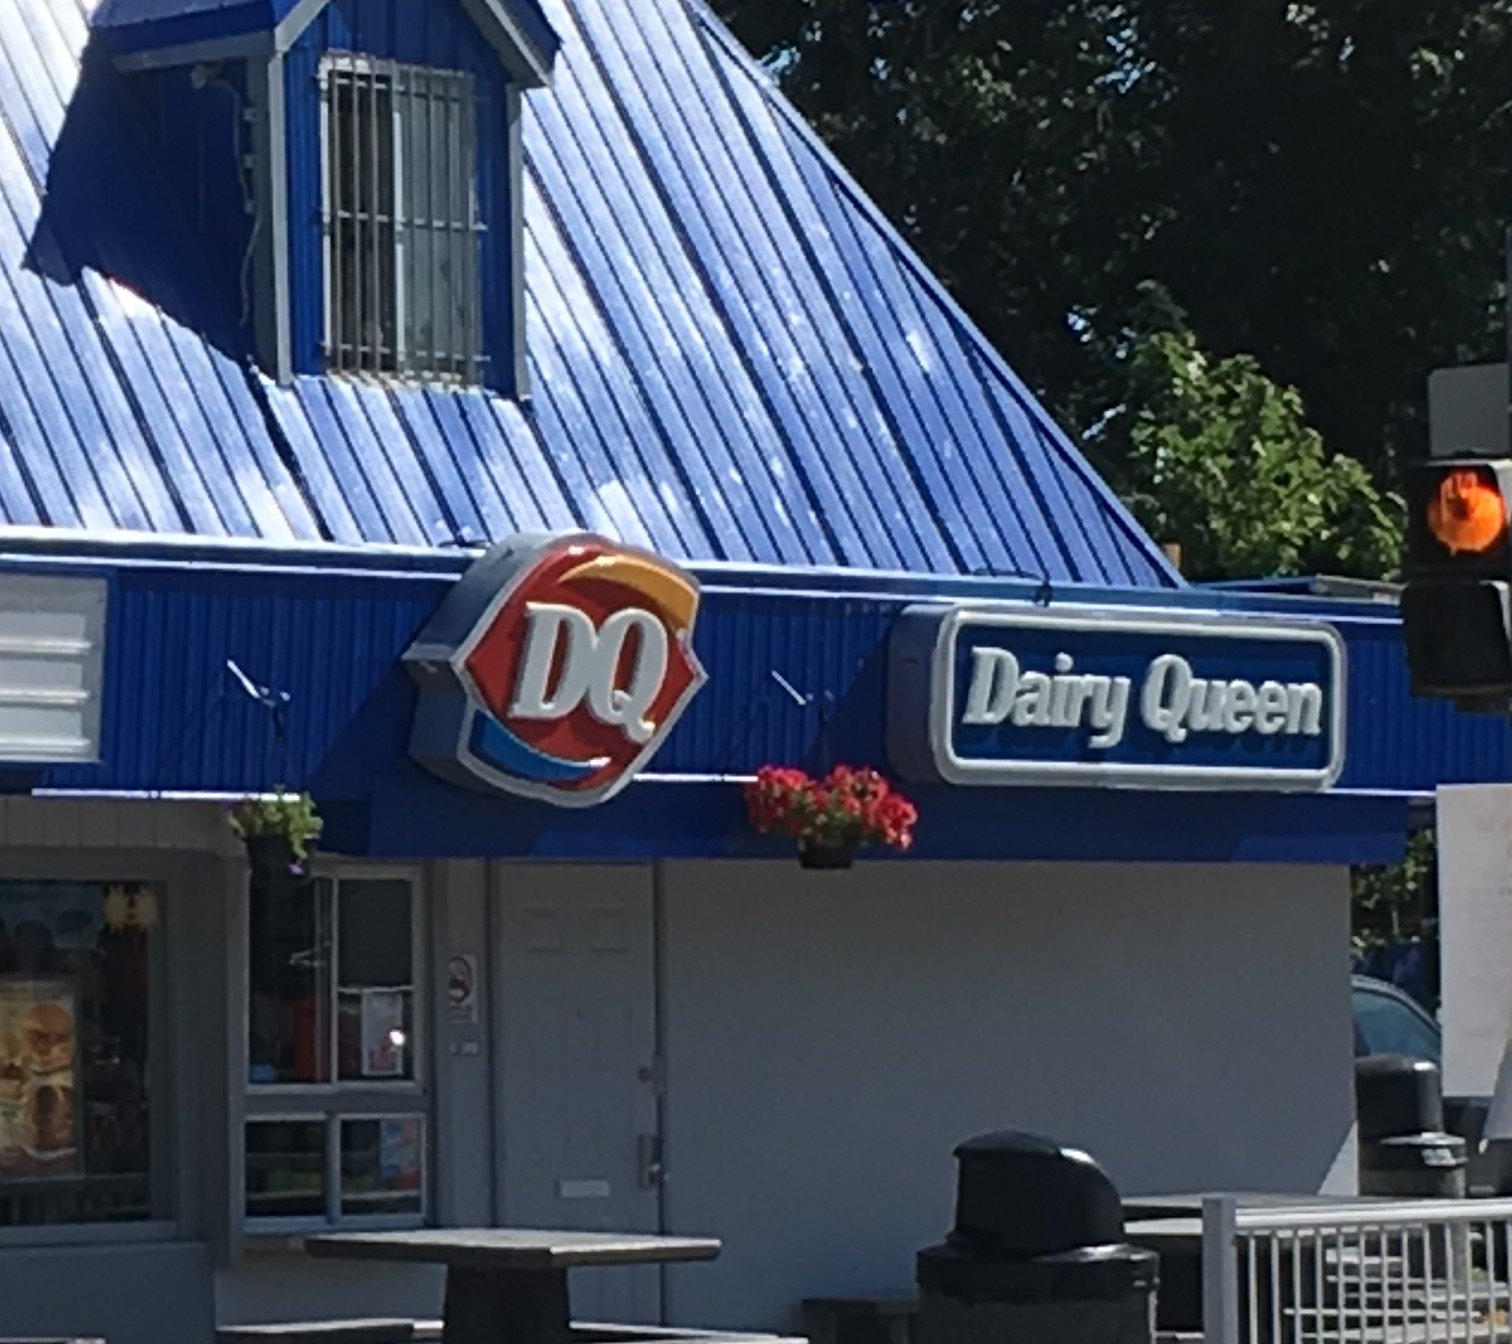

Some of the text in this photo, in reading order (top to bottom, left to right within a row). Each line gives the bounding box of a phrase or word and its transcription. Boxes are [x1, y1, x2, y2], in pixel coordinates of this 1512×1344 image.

[506, 601, 669, 745] DQ
[961, 645, 1323, 749] Dairy Queen
